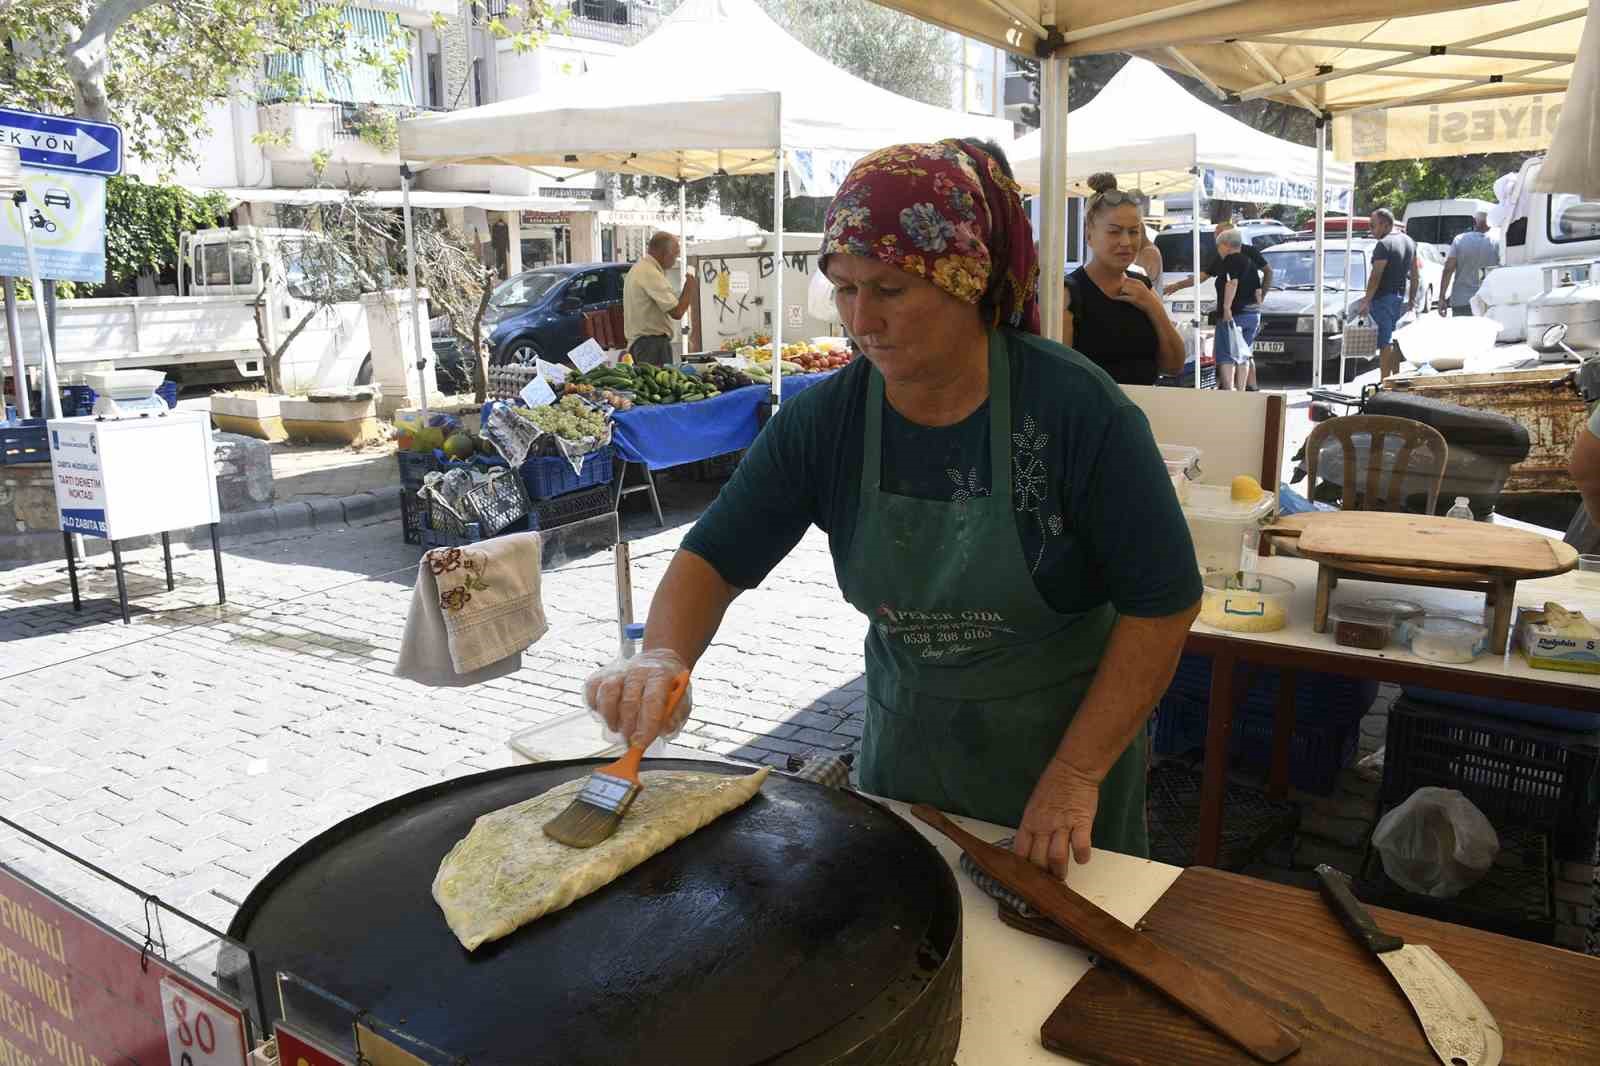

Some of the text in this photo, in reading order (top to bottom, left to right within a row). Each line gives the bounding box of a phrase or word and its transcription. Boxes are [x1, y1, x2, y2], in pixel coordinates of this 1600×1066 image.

[31, 135, 74, 152] YÖN
[1586, 640, 1595, 650] S
[172, 994, 215, 1055] 80
